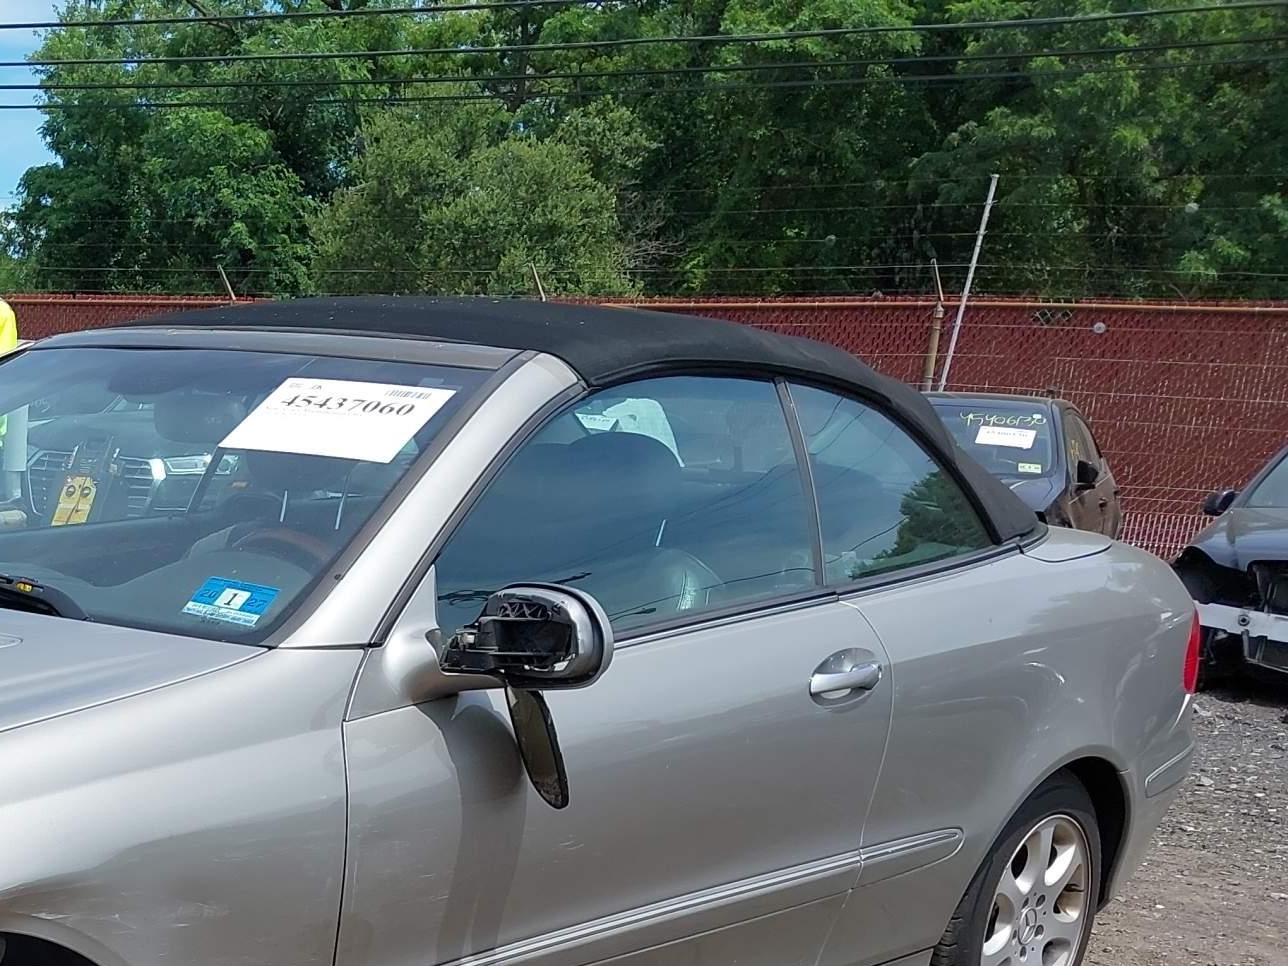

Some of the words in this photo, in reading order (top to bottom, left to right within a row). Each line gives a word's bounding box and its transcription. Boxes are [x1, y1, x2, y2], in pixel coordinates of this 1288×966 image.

[280, 394, 416, 416] 45437060
[223, 592, 238, 606] 1
[247, 599, 267, 608] 27
